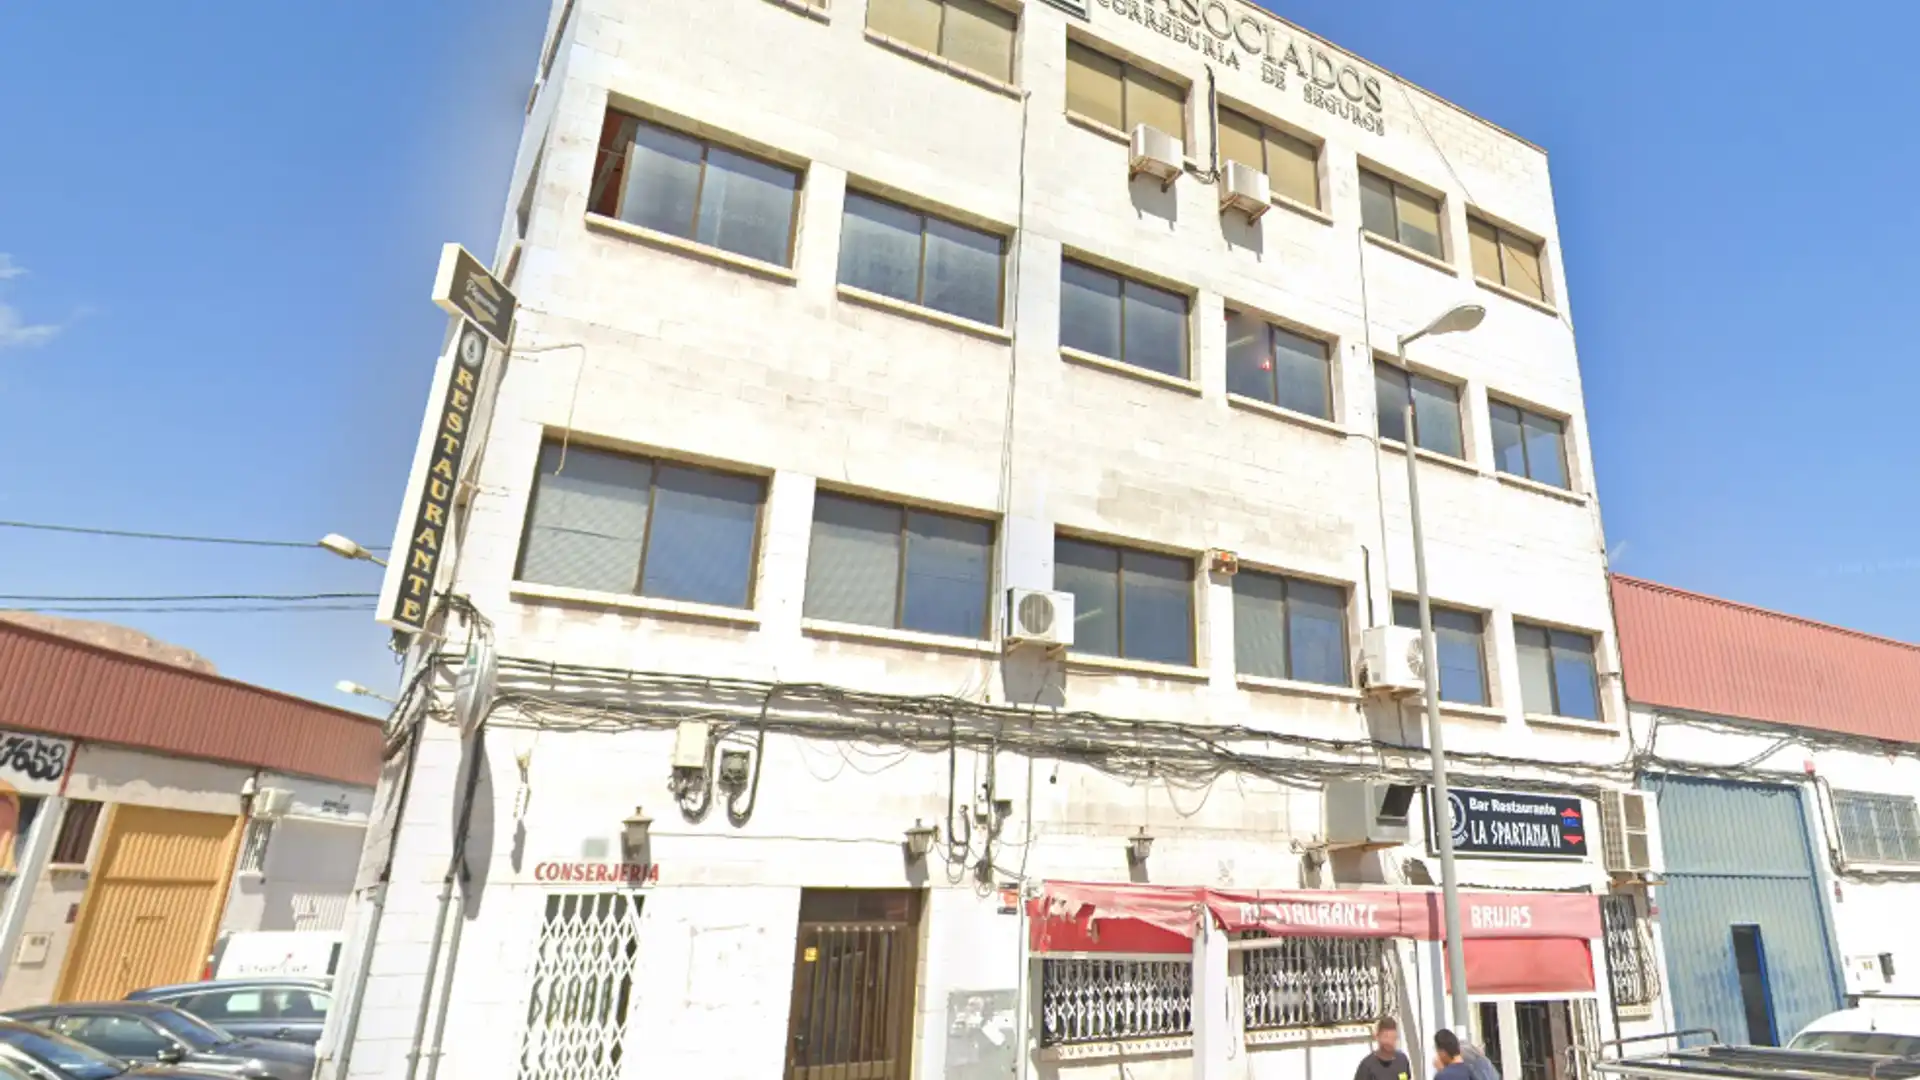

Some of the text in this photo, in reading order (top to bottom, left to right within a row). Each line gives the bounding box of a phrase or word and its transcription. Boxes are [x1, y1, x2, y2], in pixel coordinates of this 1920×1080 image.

[1261, 62, 1287, 91] DE
[1302, 82, 1385, 137] SEGUROS
[400, 366, 474, 622] RESTAURANTE
[1469, 797, 1556, 816] Bar Restaurante
[1470, 820, 1488, 845] LA
[1491, 820, 1550, 848] SPARTANA
[535, 862, 659, 882] CONSERJERIA
[1470, 905, 1532, 928] BRUJAS
